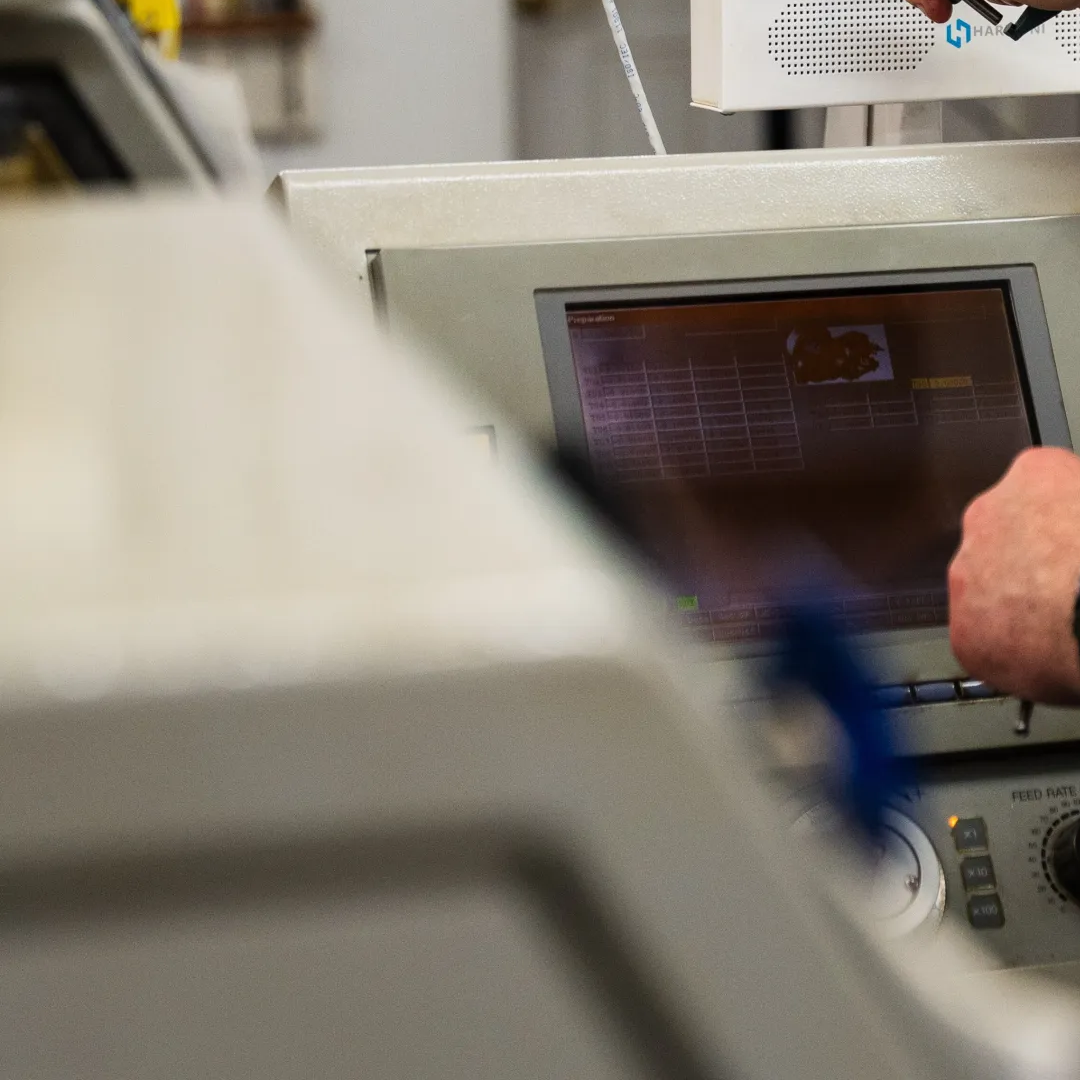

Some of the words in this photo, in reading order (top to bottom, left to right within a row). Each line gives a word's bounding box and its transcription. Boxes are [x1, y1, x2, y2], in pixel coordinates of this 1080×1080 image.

[973, 24, 1045, 36] HARNI
[567, 313, 615, 324] Preparation
[1012, 790, 1042, 802] FEED
[1047, 787, 1076, 798] RATE
